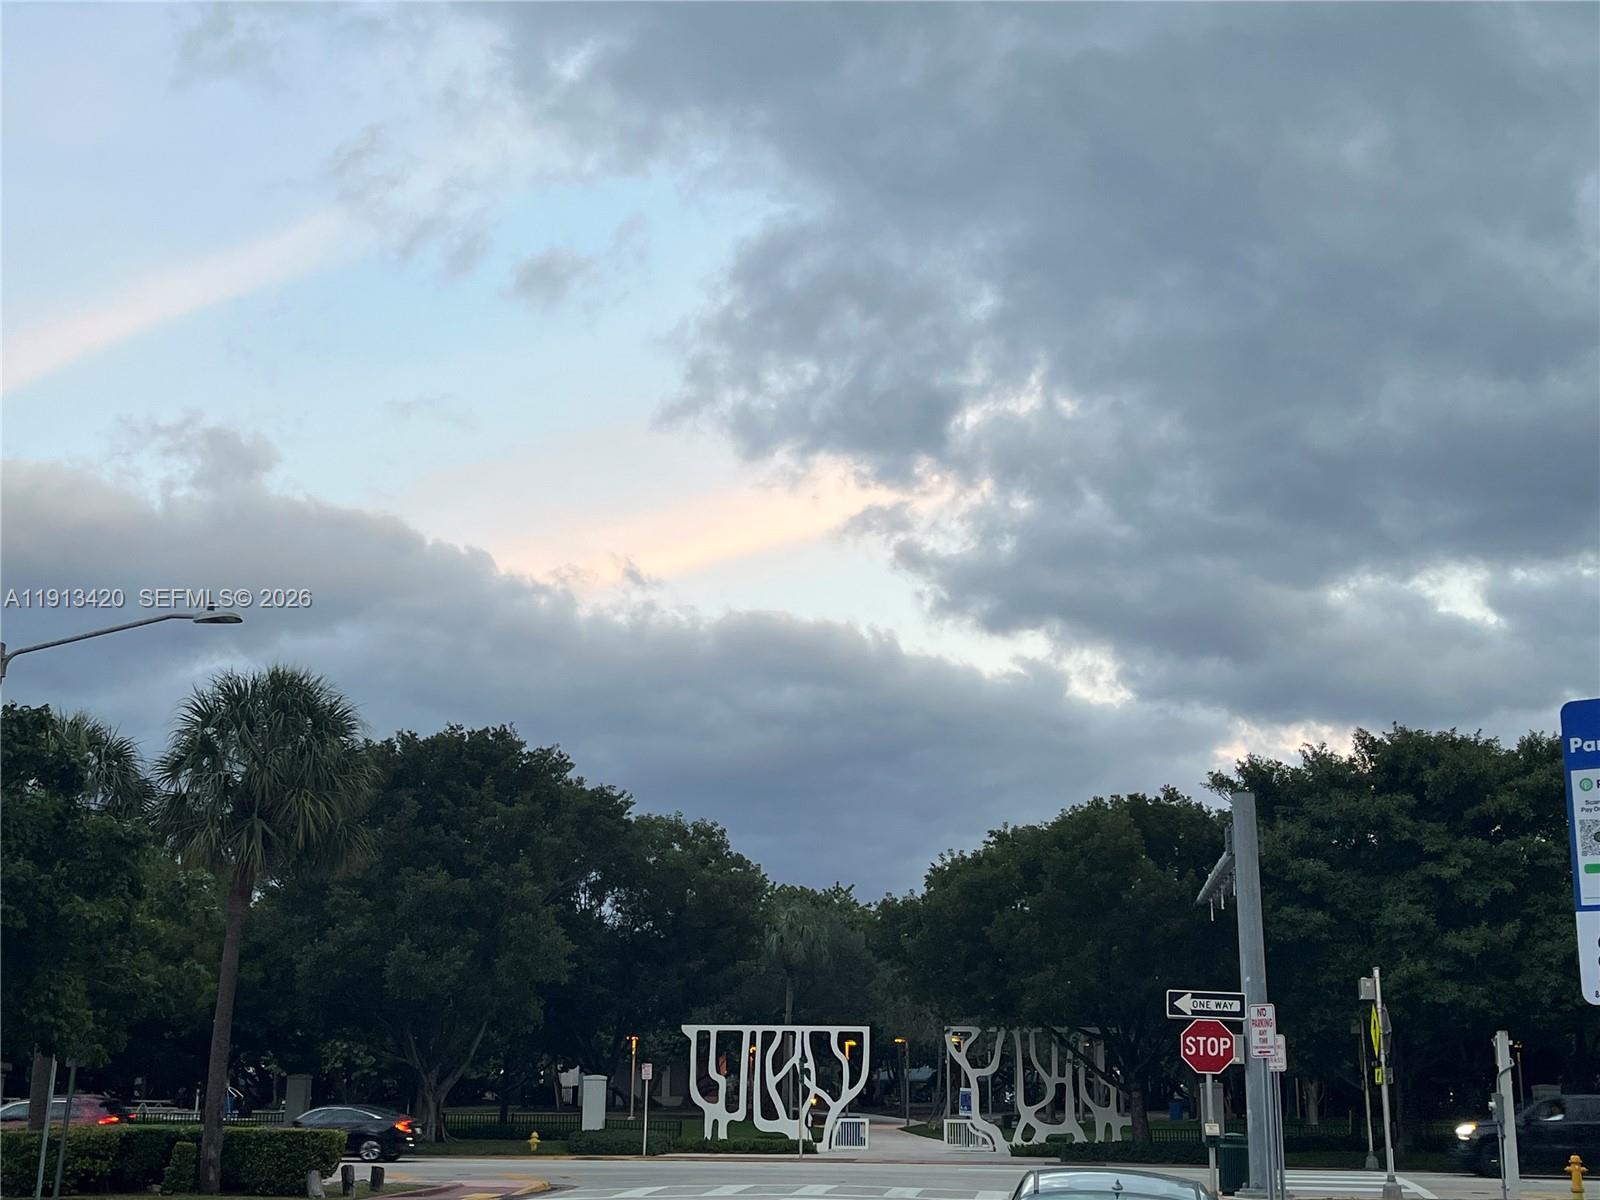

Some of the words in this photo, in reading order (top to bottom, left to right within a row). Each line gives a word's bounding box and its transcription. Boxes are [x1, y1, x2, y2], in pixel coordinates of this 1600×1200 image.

[1192, 1000, 1211, 1009] ONE
[1215, 1001, 1234, 1010] WAY
[1256, 1007, 1267, 1017] NO
[1251, 1018, 1273, 1028] PARKING
[1185, 1036, 1231, 1056] STOP
